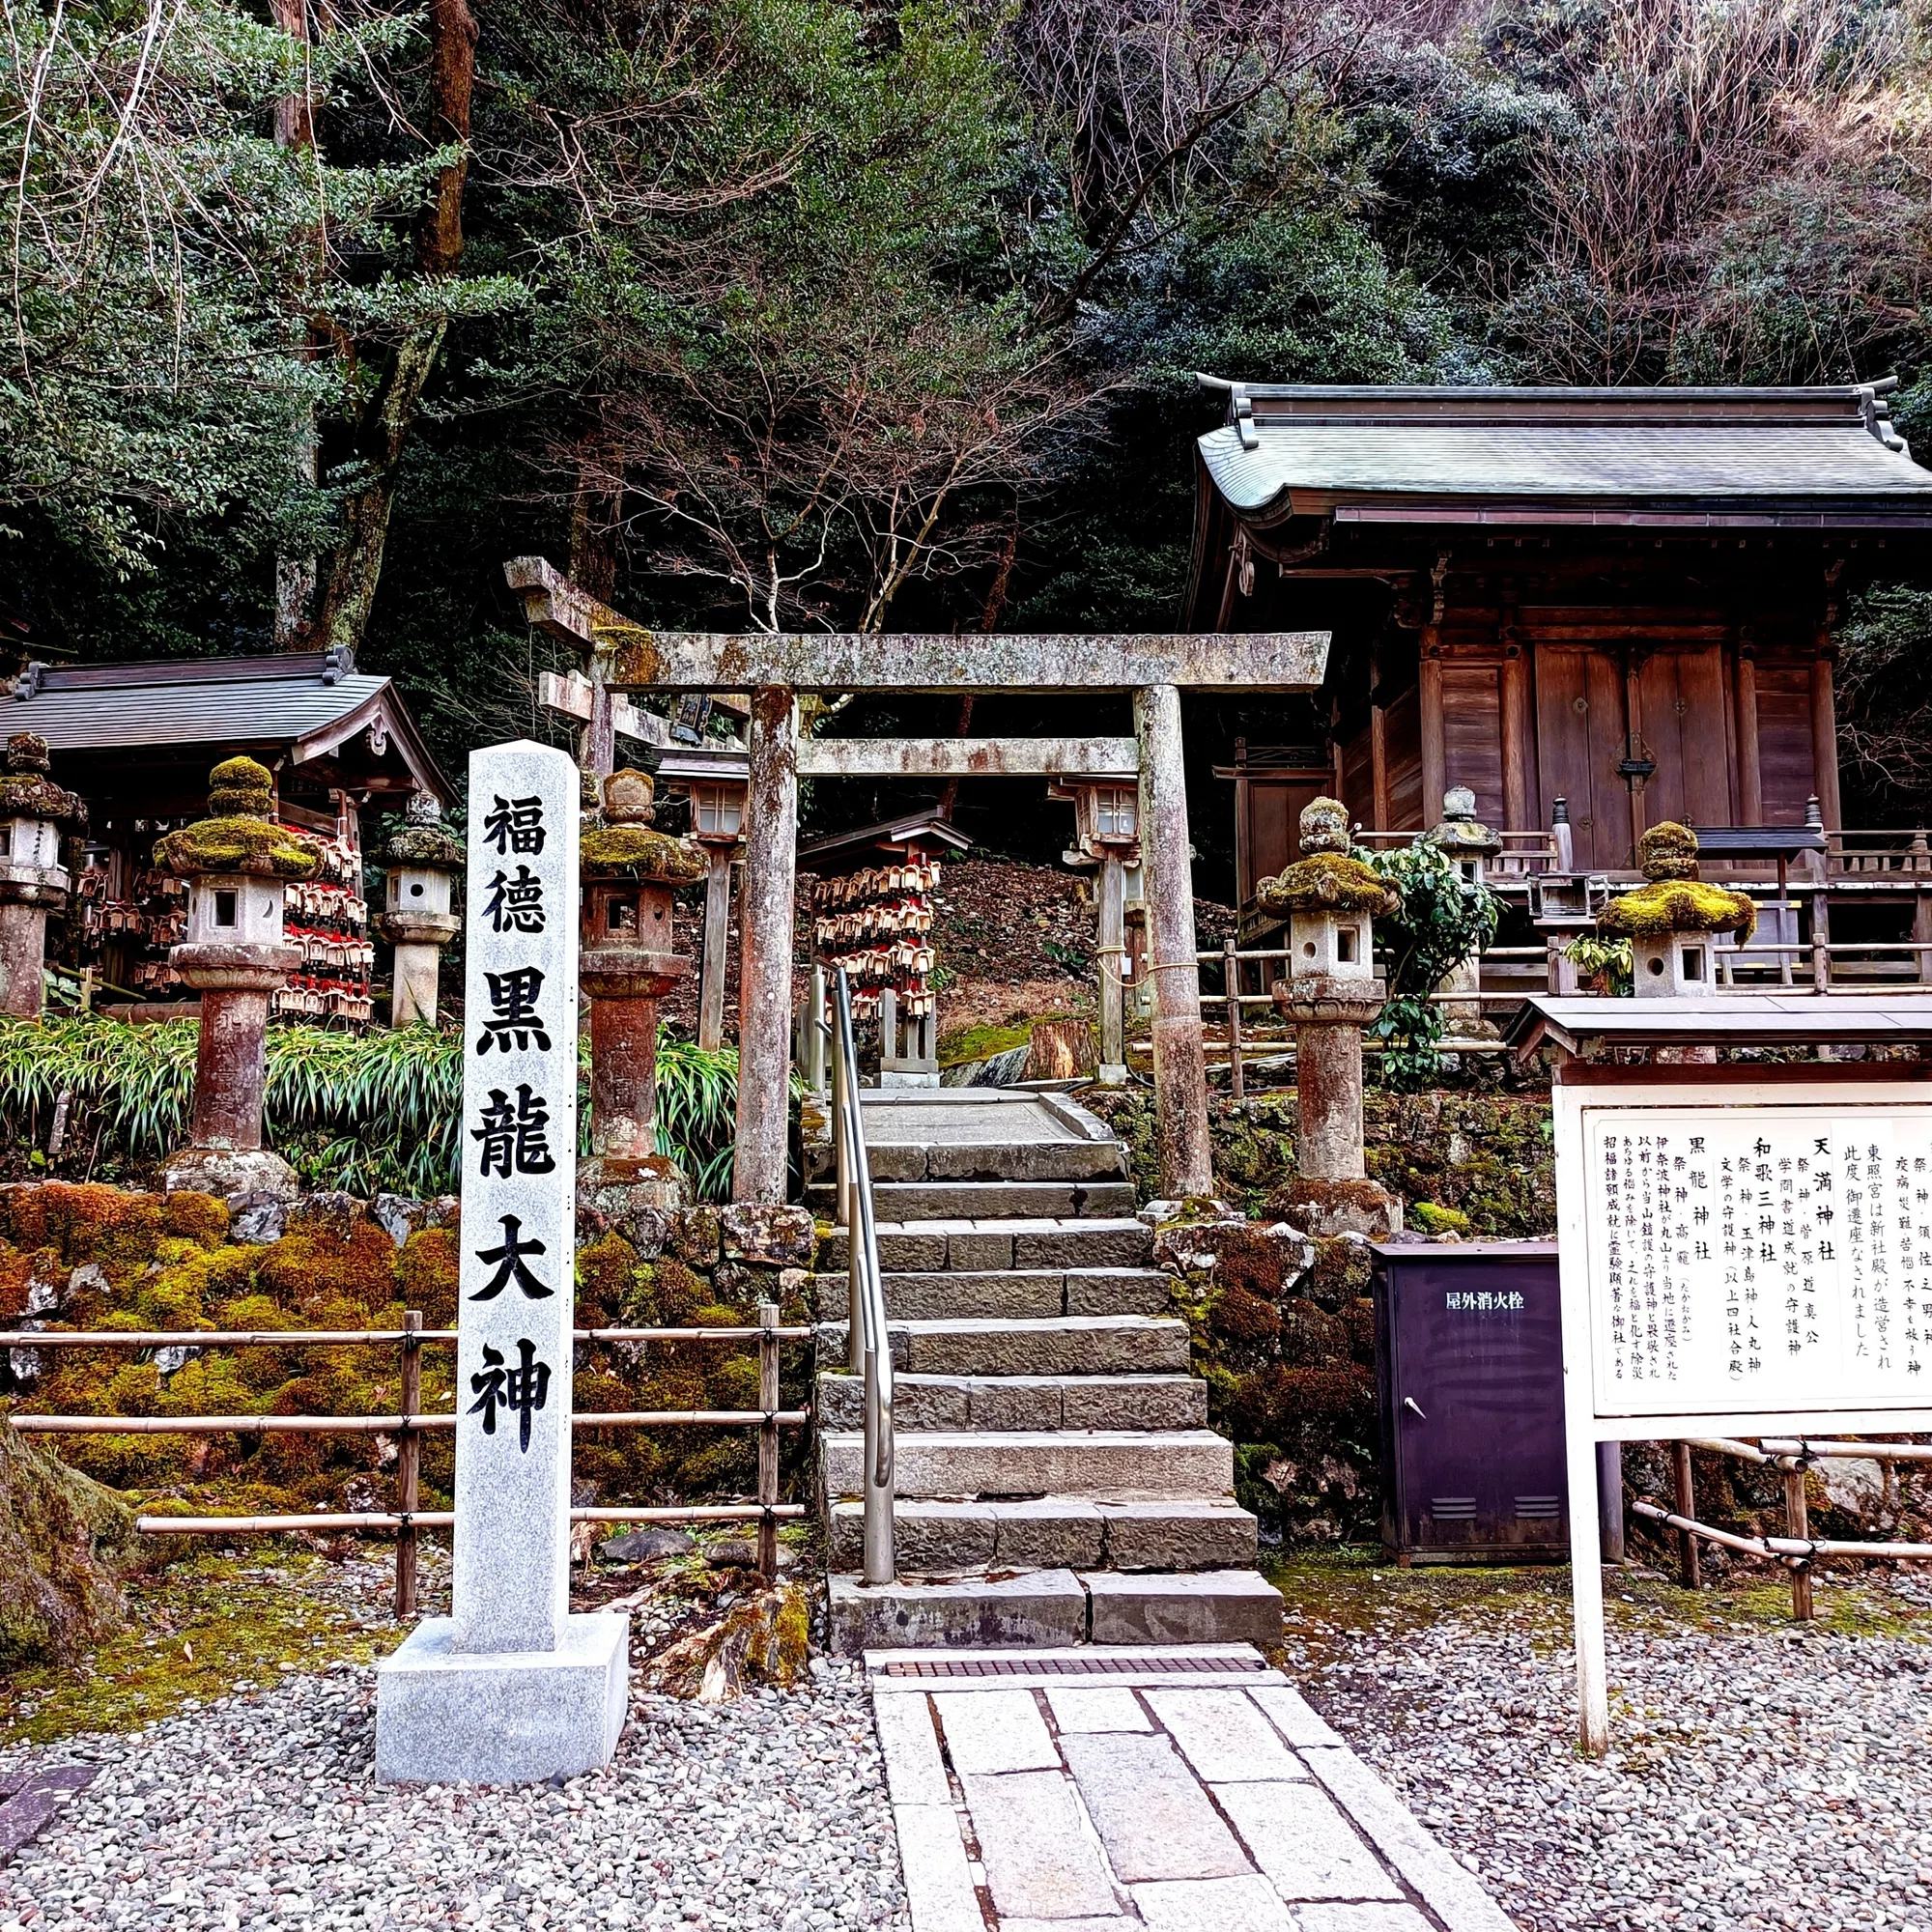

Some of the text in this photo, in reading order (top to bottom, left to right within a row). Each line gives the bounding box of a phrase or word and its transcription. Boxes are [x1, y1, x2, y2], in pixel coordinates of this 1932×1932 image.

[1688, 1136, 1712, 1262] 黒龍神社
[1753, 1136, 1777, 1264] 和歌三神社
[1777, 1157, 1802, 1356] 学問書道成就の守護神
[1812, 1137, 1836, 1262] 天満神社
[1866, 1143, 1892, 1370] 東照宮は新社殿が造営され
[1446, 1292, 1524, 1310] 屋外消火栓
